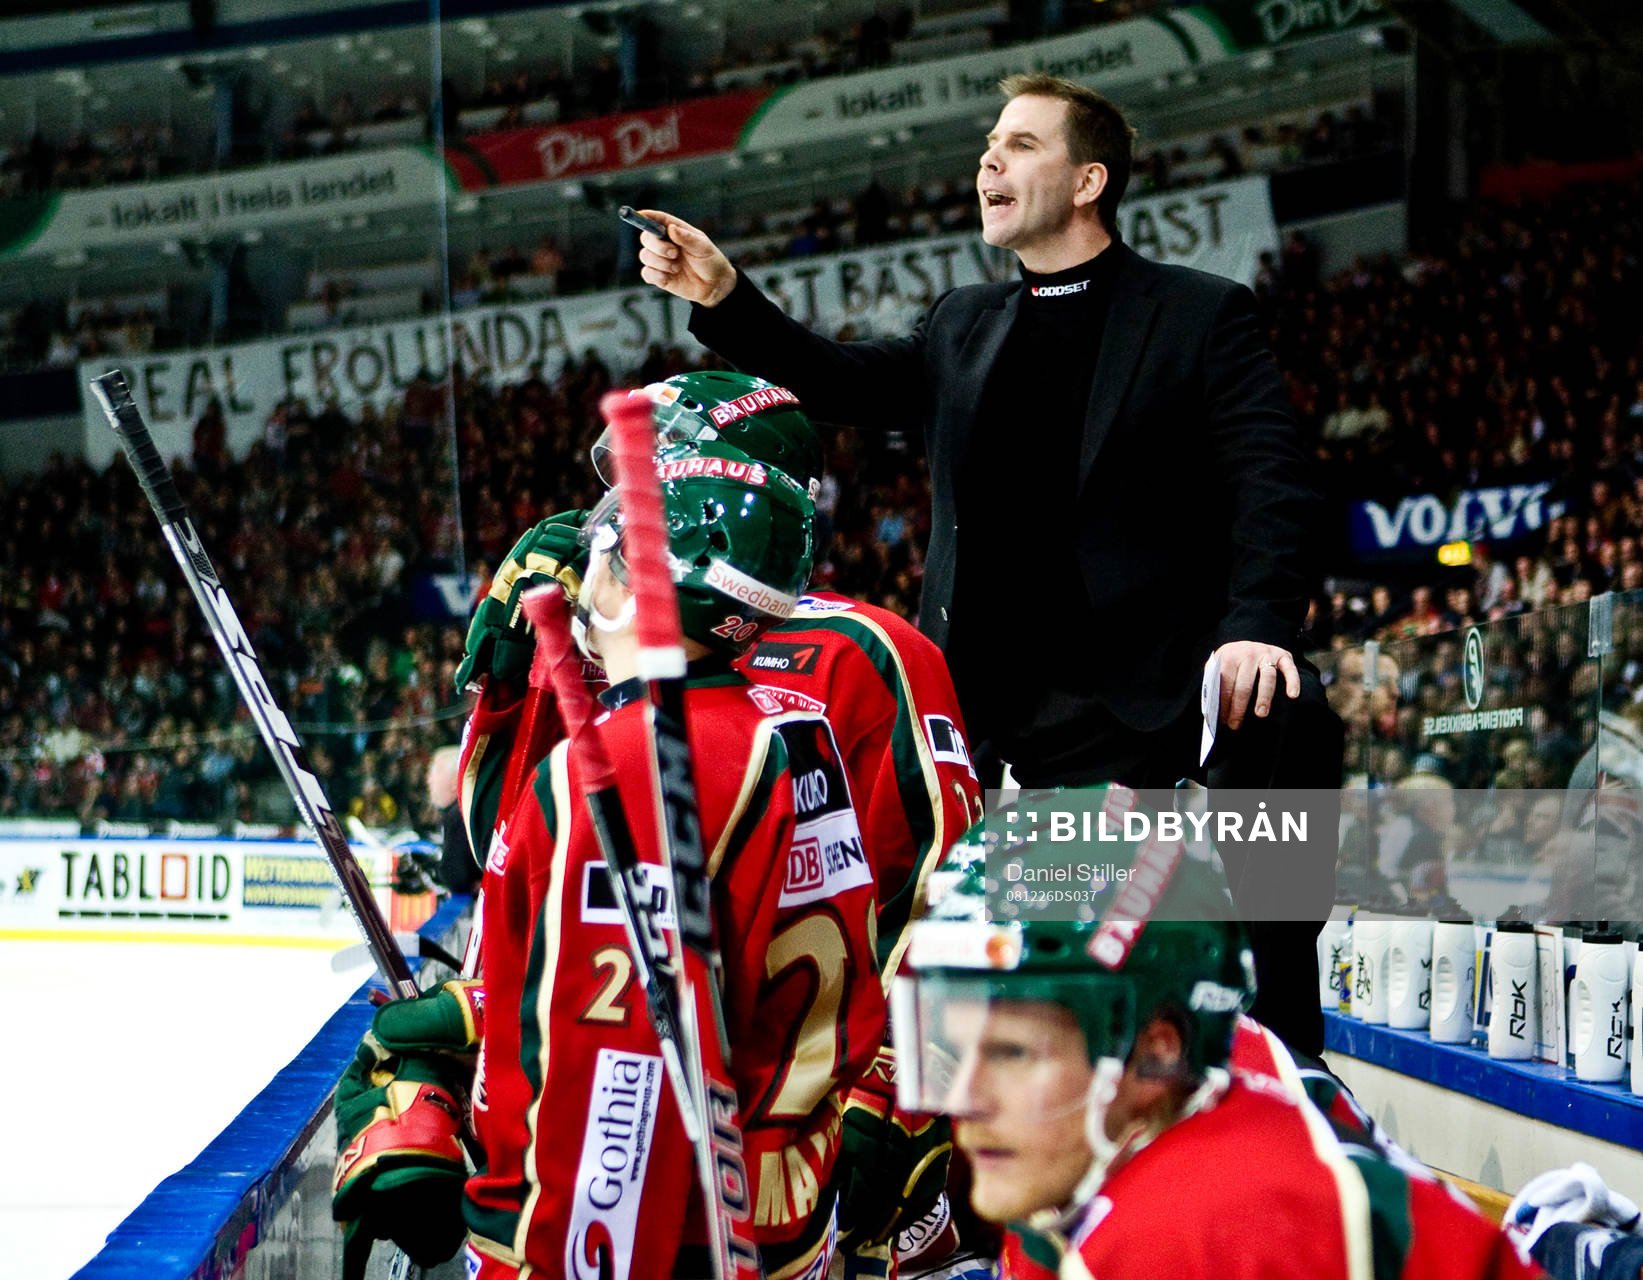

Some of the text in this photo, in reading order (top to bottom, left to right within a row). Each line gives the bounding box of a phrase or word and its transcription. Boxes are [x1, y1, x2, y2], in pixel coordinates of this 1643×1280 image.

[537, 112, 680, 176] Din Del
[111, 192, 197, 229] lokalt
[298, 166, 396, 204] landet
[1038, 280, 1091, 297] ODDSET
[710, 615, 758, 642] 20
[753, 656, 790, 669] KUMHO
[789, 846, 820, 885] DB
[579, 946, 635, 1025] 2
[588, 1058, 642, 1211] Gothia
